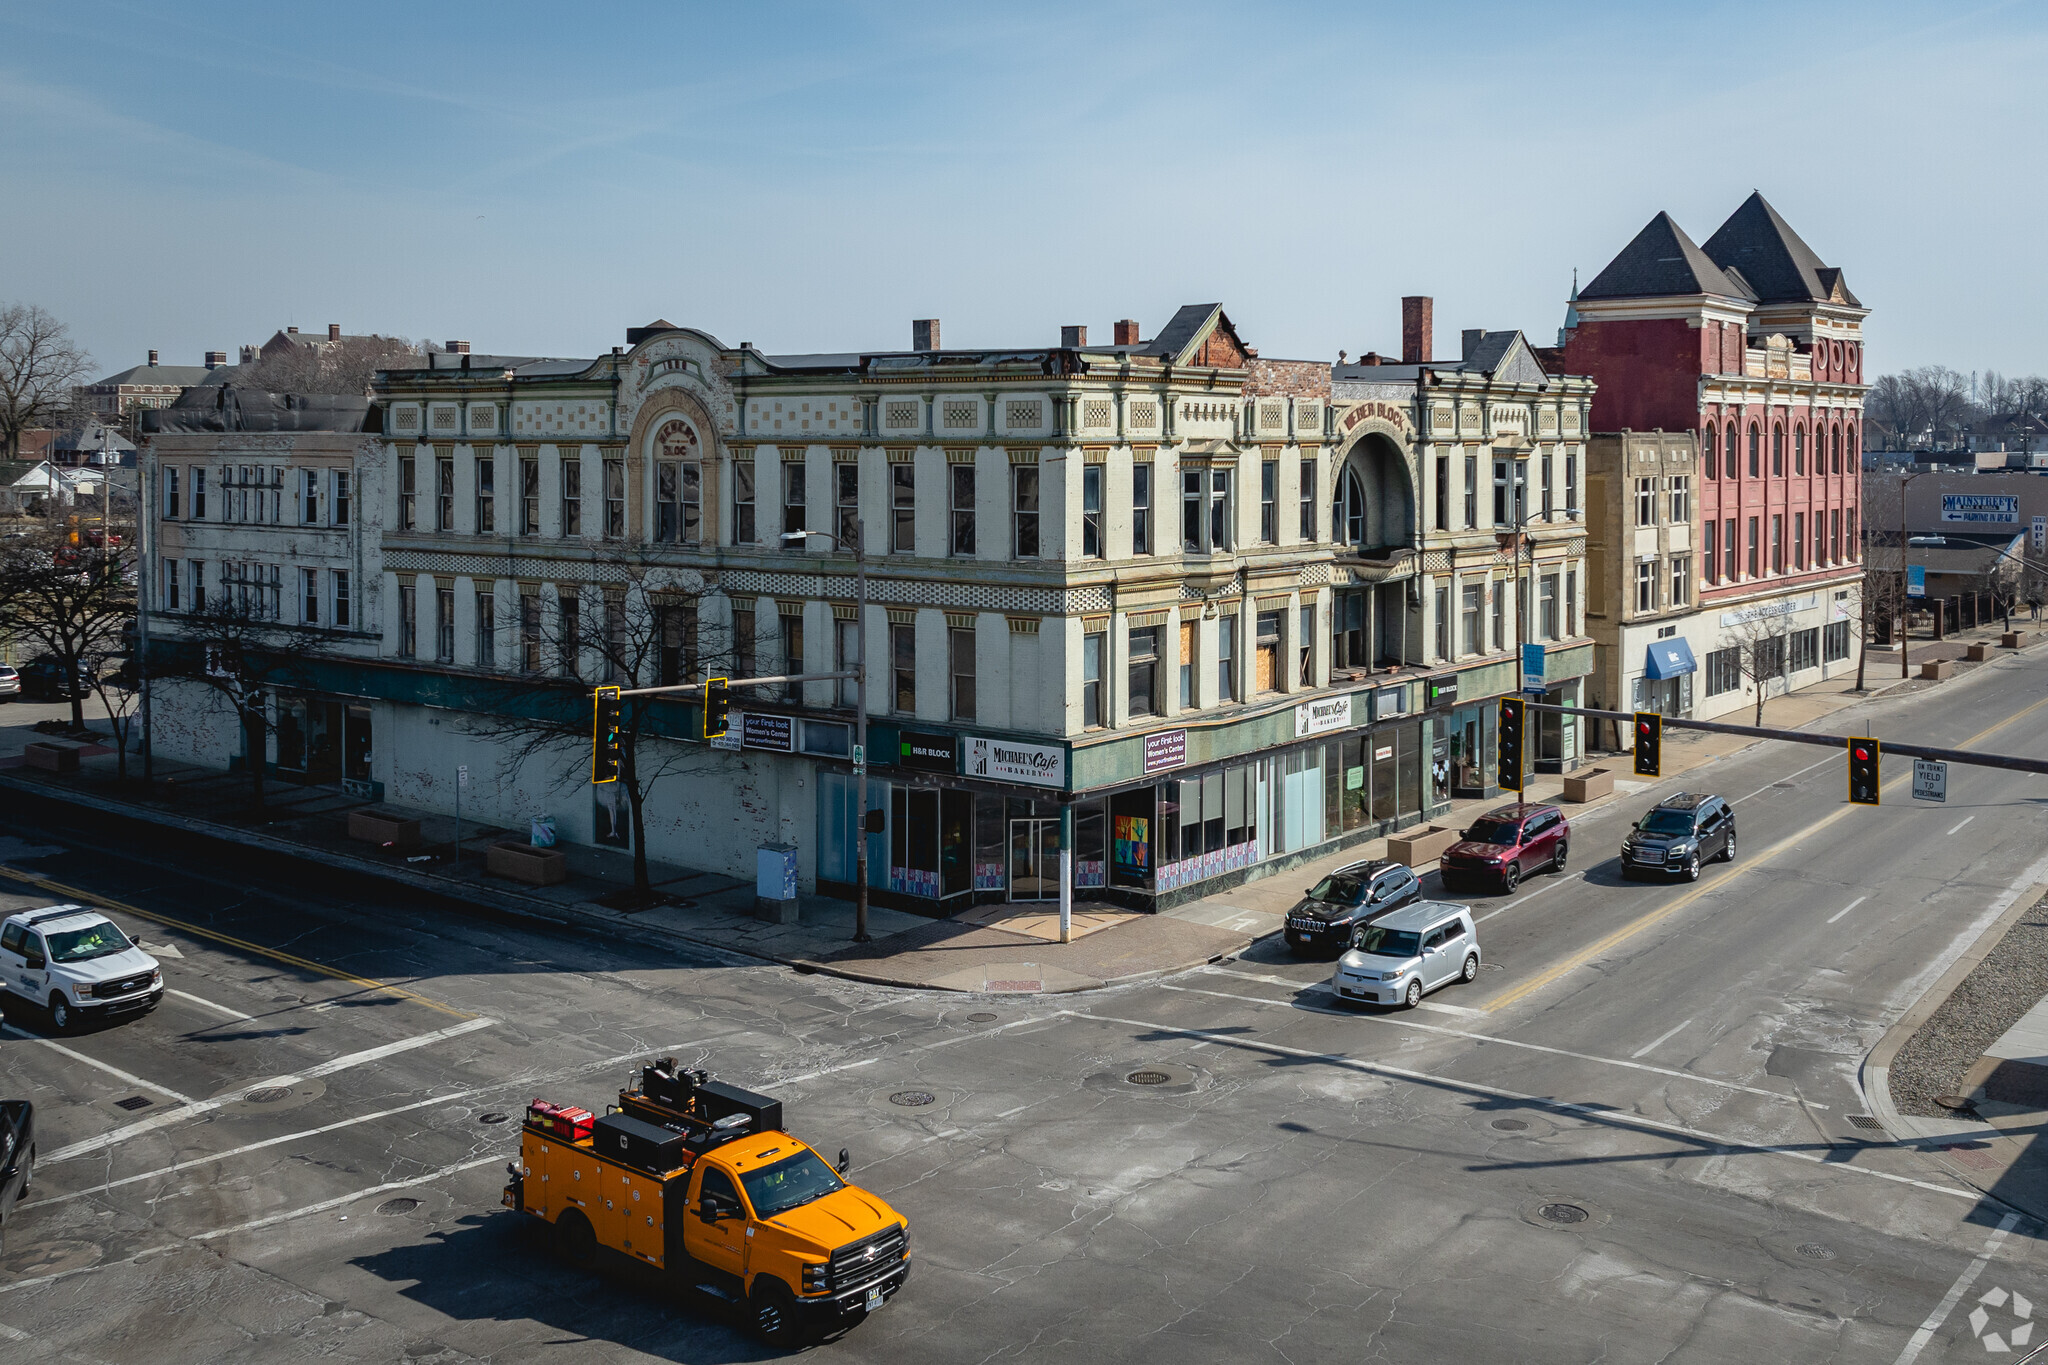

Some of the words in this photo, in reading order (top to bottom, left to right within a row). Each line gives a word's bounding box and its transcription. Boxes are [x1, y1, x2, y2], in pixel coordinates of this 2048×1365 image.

[1344, 402, 1375, 431] WEBER
[1377, 402, 1405, 432] BLOCK
[1946, 496, 2013, 511] MAINSTREET
[1964, 513, 1988, 522] PARKING
[1990, 514, 1996, 522] IN
[1997, 514, 2012, 522] REAR
[761, 719, 774, 727] first
[776, 721, 789, 729] look
[746, 727, 770, 736] Women's
[770, 730, 789, 738] Center
[1148, 740, 1160, 750] your
[1161, 736, 1172, 745] first
[1173, 734, 1184, 742] look
[912, 746, 927, 756] H&R
[928, 748, 950, 759] BLOCK
[1148, 748, 1168, 757] Women's
[1169, 745, 1184, 753] Center
[994, 747, 1032, 765] MICHAEL'S
[1033, 752, 1058, 771] Cafe
[1008, 767, 1042, 777] BAKERY
[1927, 764, 1944, 772] TURNS
[1919, 771, 1940, 781] YIELD
[1915, 789, 1943, 798] PEDESTRIANS
[869, 1288, 880, 1300] CAT
